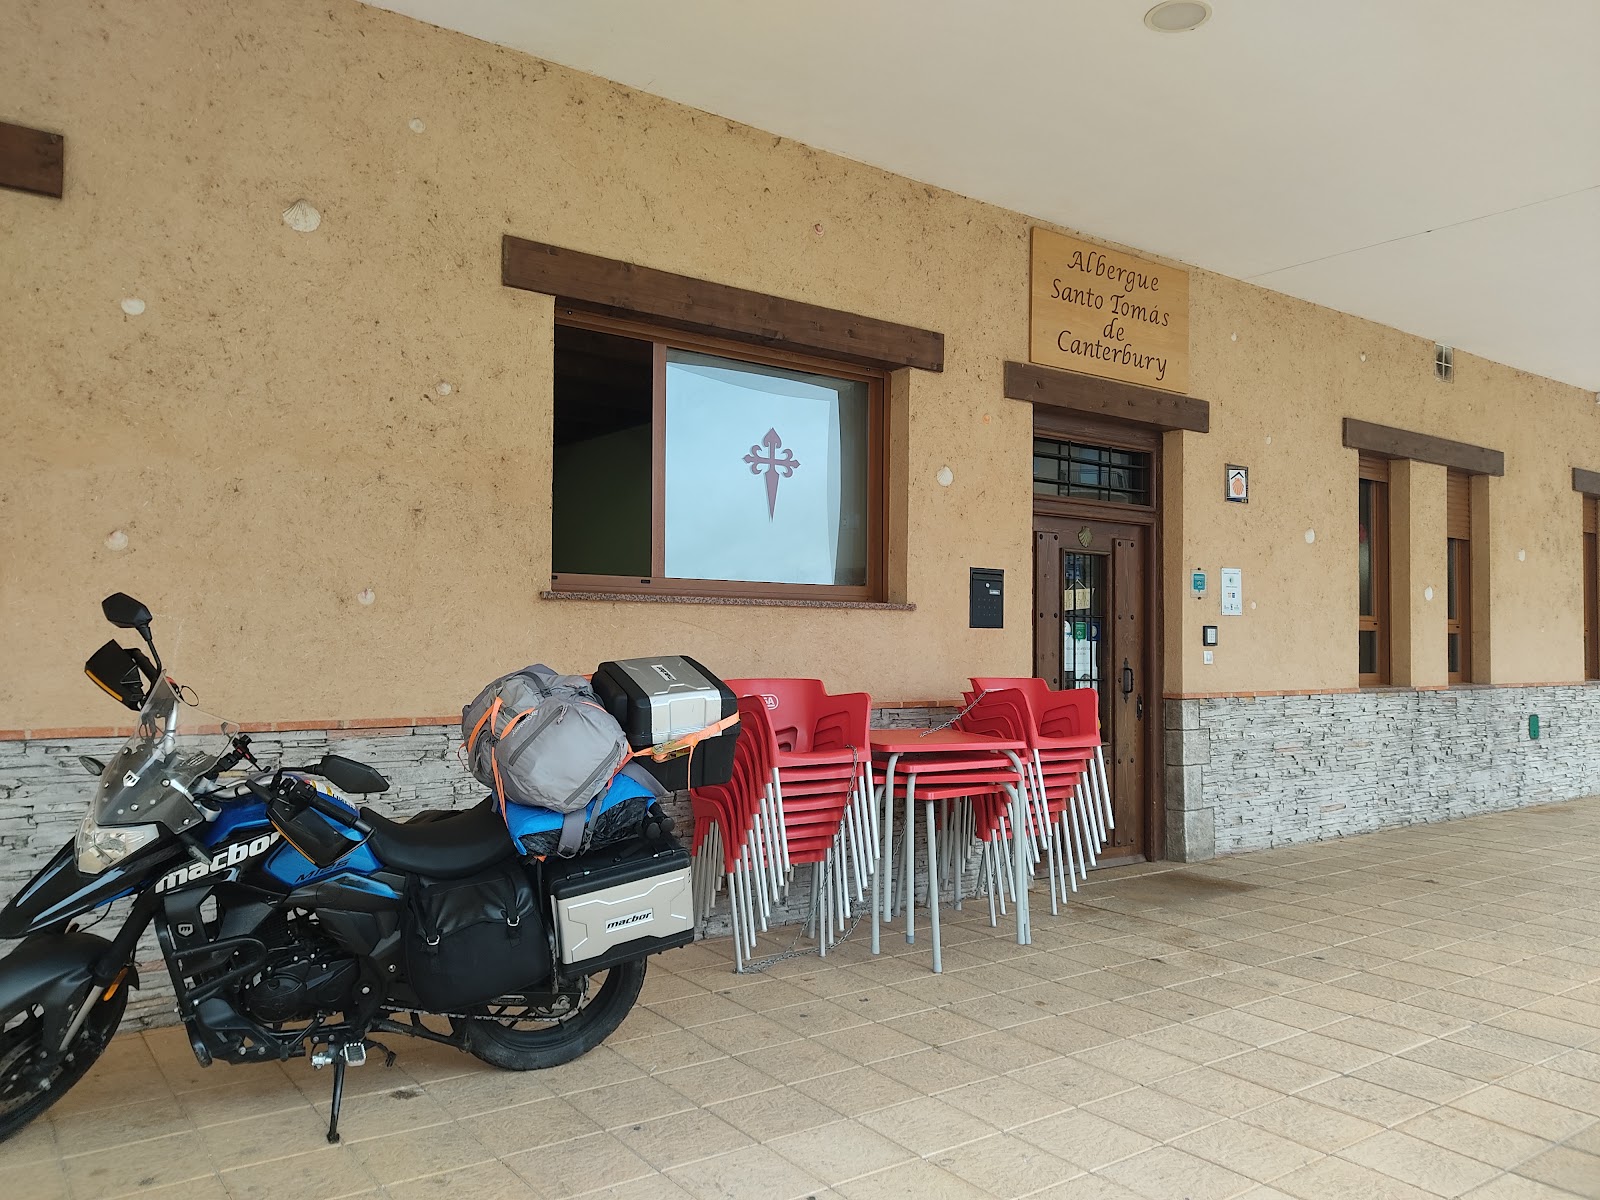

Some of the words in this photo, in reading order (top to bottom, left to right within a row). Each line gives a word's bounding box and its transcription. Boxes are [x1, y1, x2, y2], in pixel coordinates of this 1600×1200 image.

[1067, 251, 1159, 293] Albergue
[1050, 278, 1104, 310] Santo
[1110, 294, 1170, 327] Tomás
[1103, 317, 1125, 341] de
[1057, 330, 1167, 381] Canterbury
[606, 912, 652, 930] macbor
